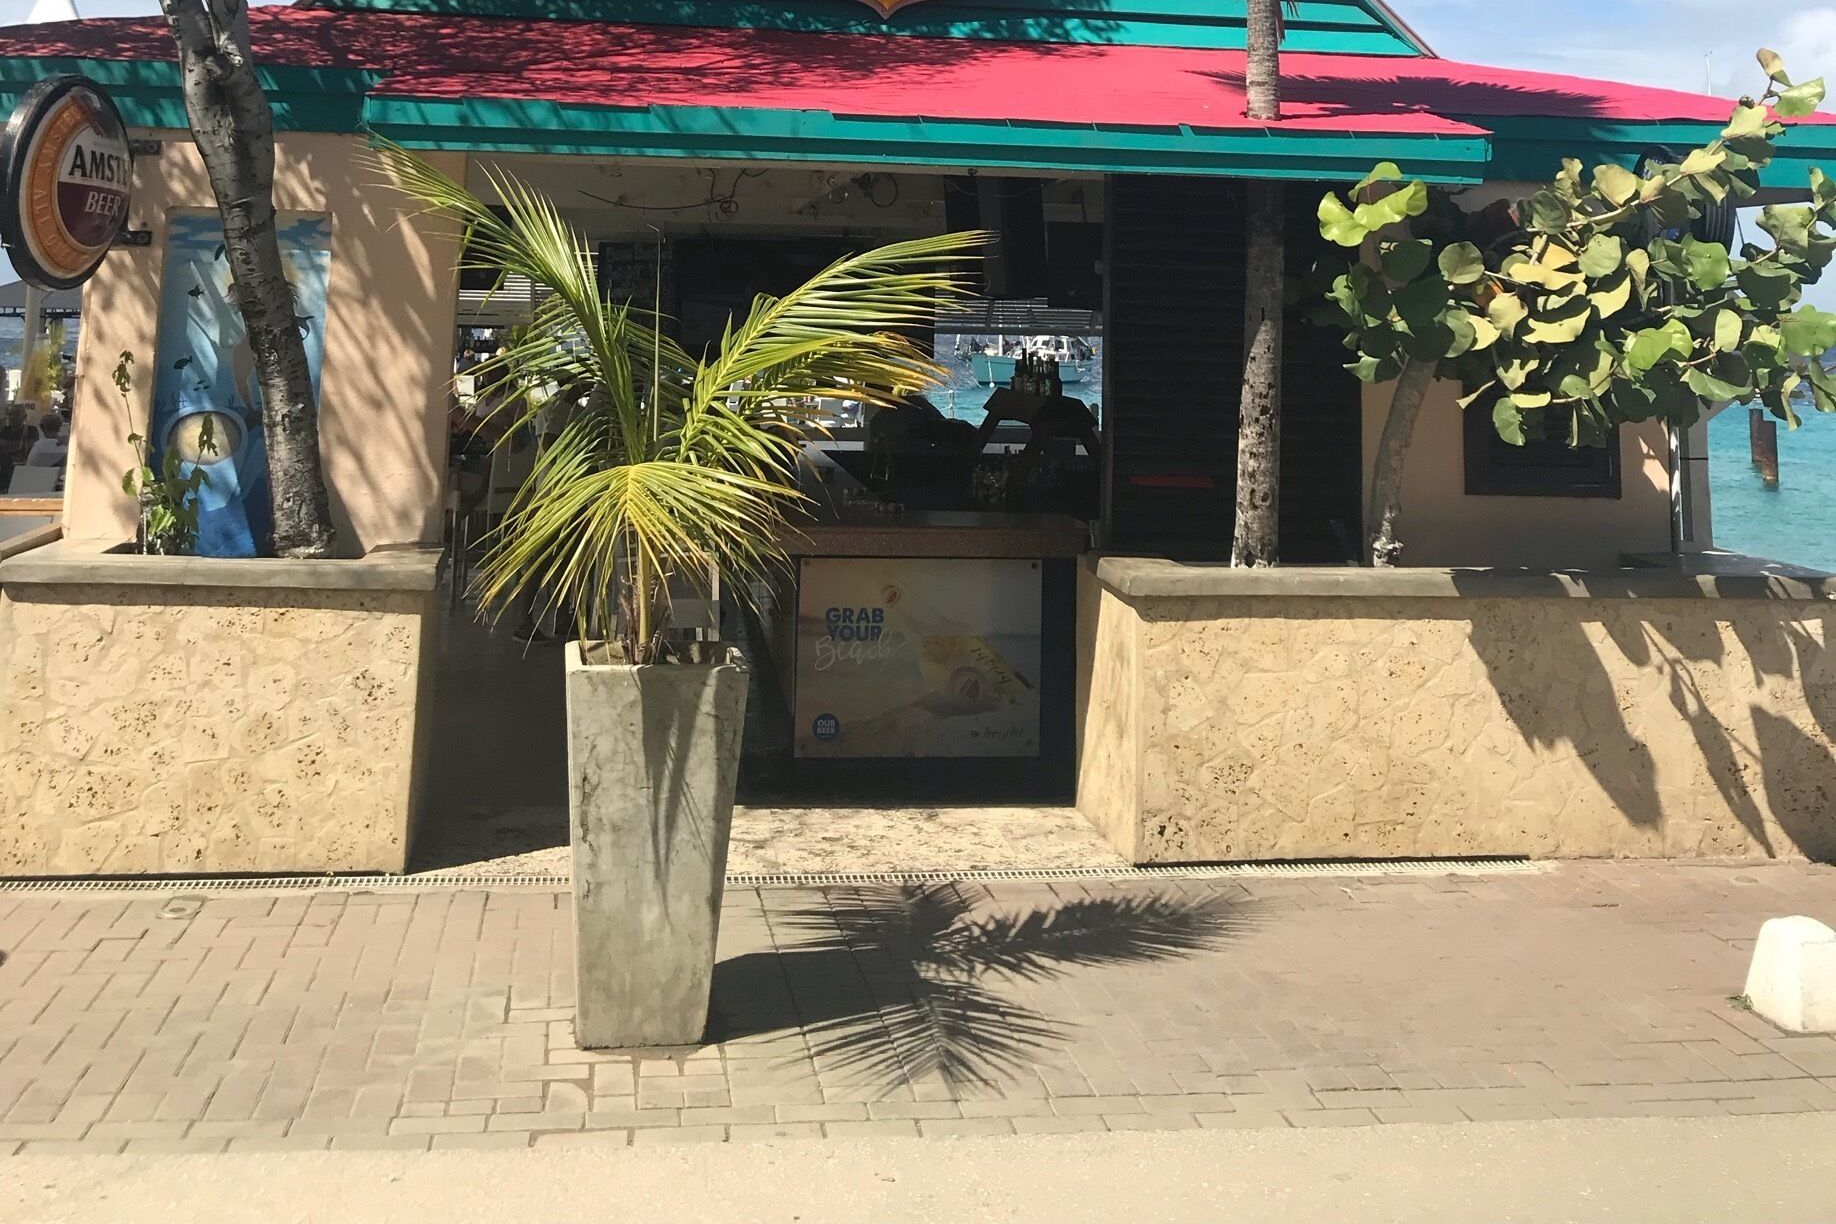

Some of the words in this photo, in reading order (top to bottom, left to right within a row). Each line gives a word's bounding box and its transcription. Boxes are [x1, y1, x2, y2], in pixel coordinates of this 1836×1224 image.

[68, 144, 129, 187] AMSTE
[84, 190, 122, 217] BEER
[825, 607, 885, 624] GRAB
[827, 625, 882, 641] YOUR
[814, 630, 906, 671] Beach
[817, 719, 836, 727] OUR
